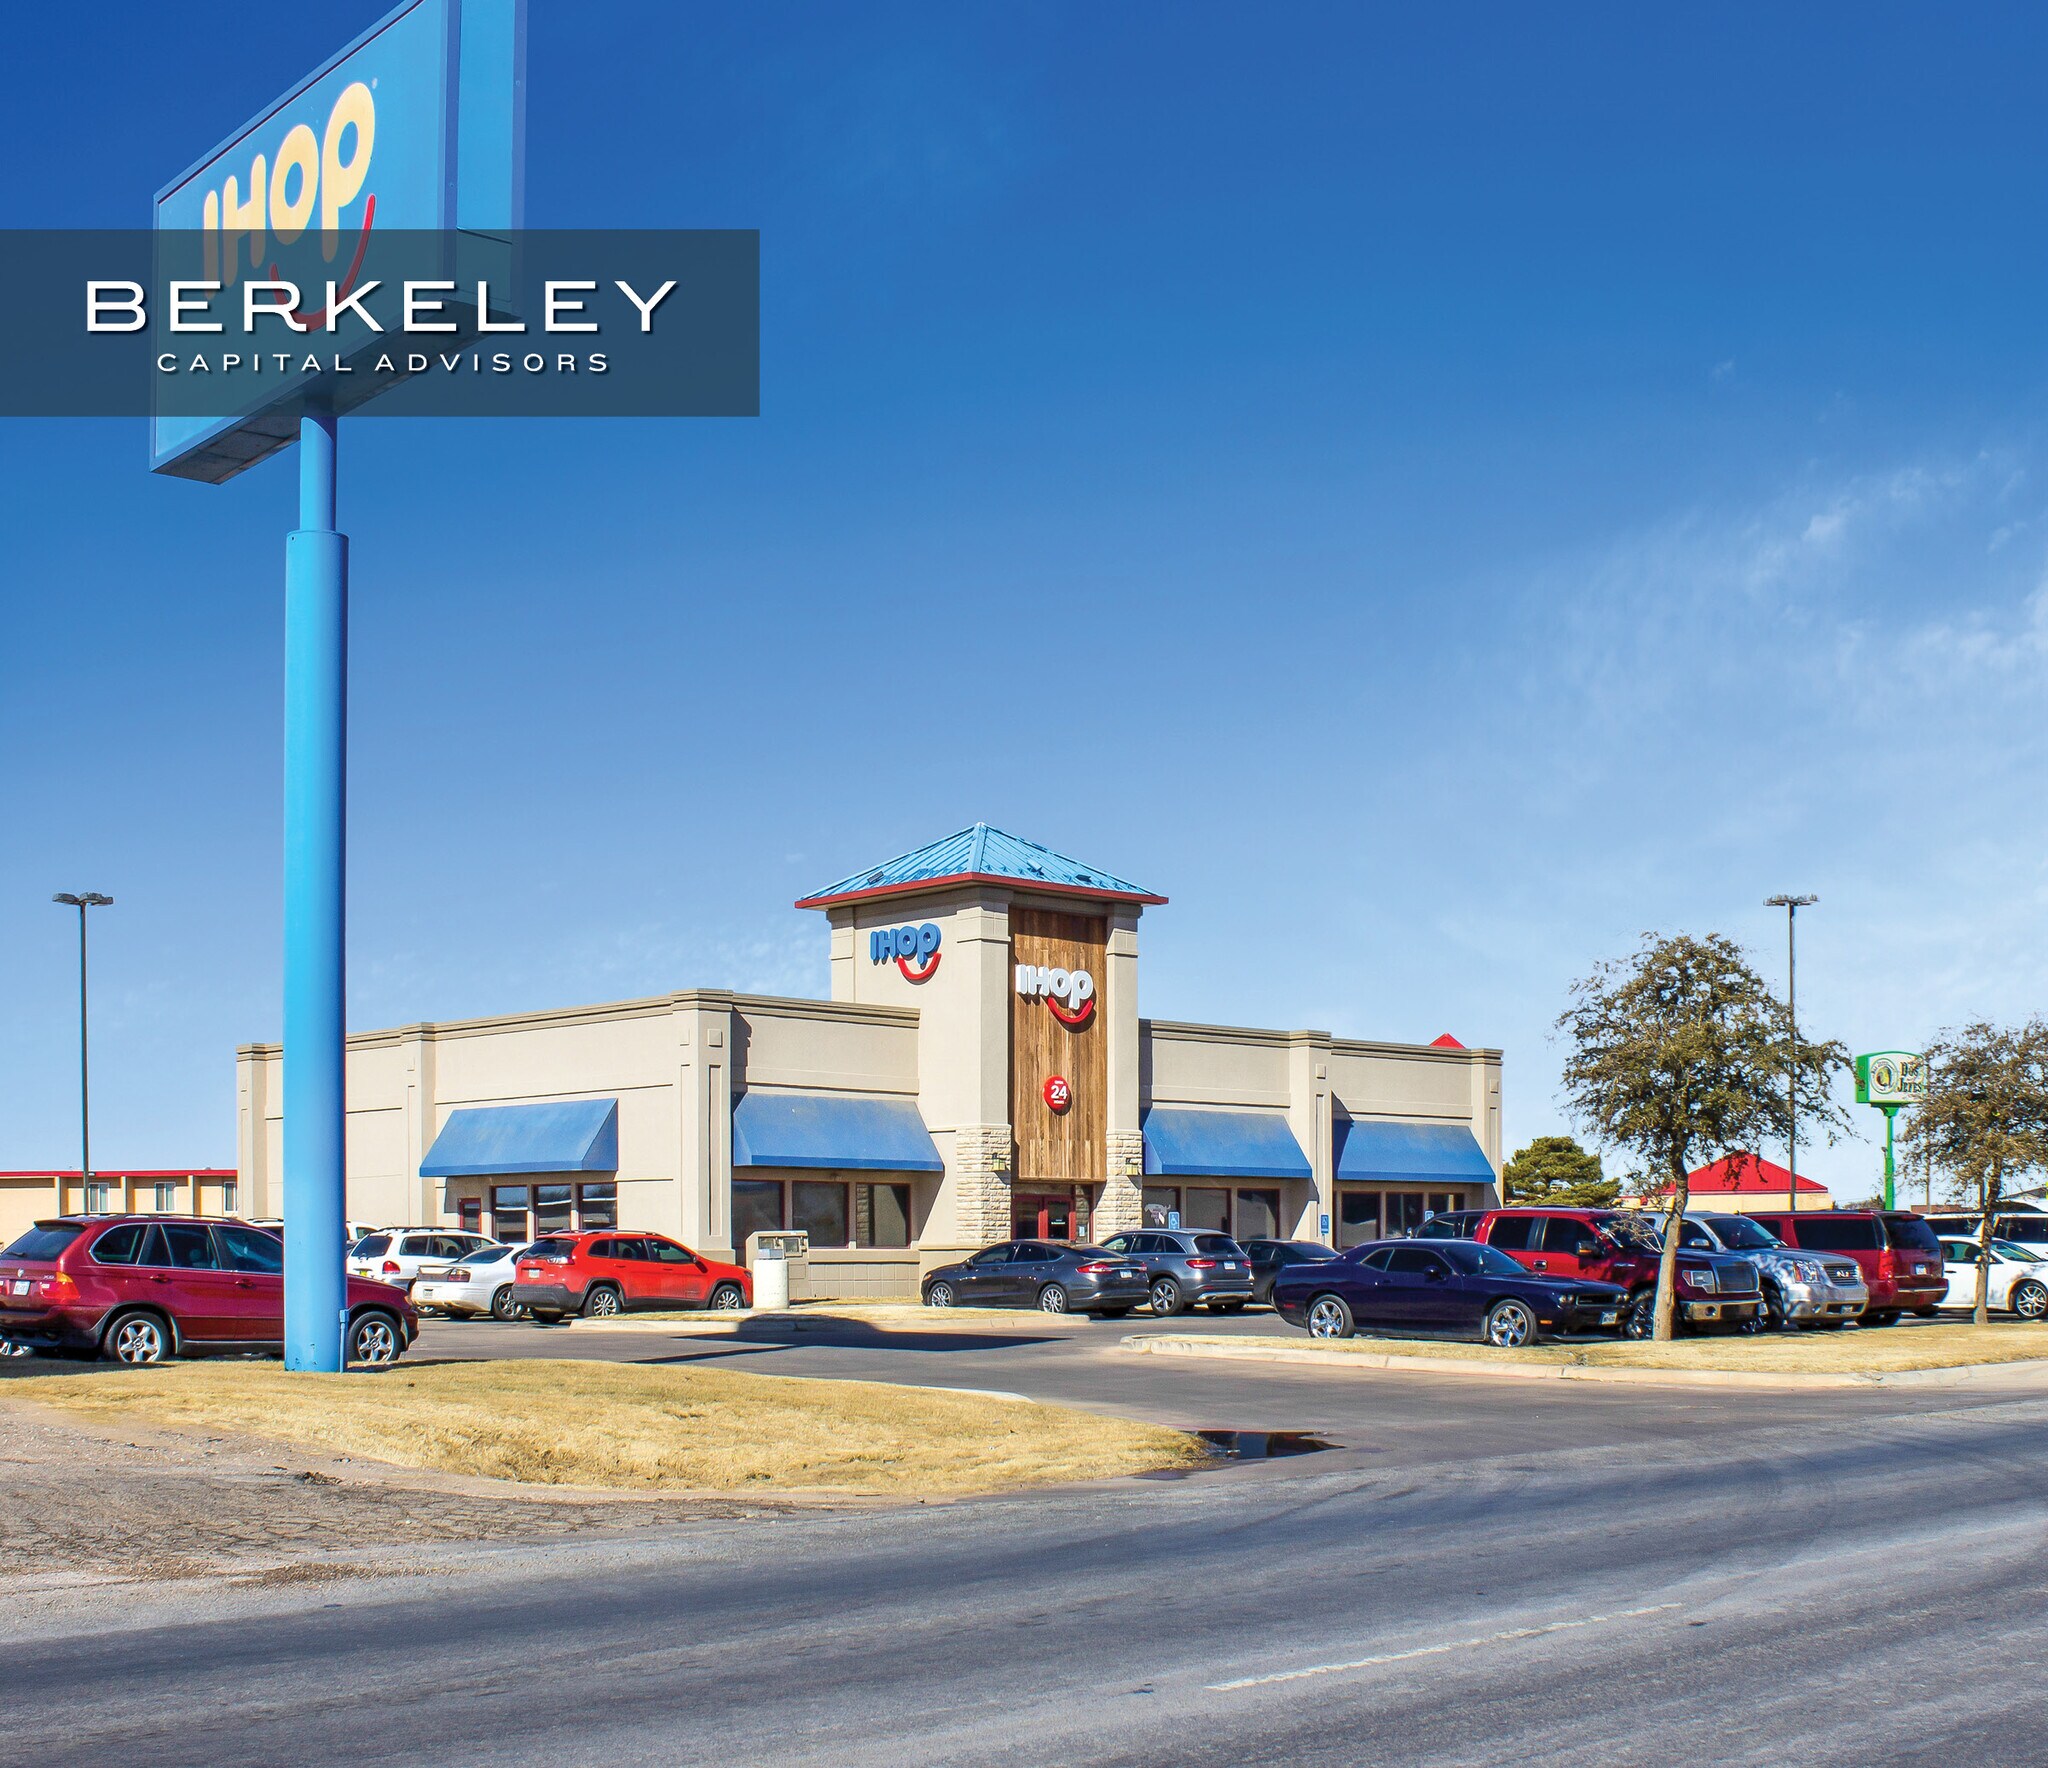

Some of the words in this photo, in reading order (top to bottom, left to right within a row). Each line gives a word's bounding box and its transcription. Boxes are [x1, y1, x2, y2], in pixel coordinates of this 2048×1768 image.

[203, 82, 375, 301] IHOP
[870, 923, 942, 966] IHOP
[1015, 964, 1094, 1010] IHOP
[1050, 1084, 1068, 1100] 24
